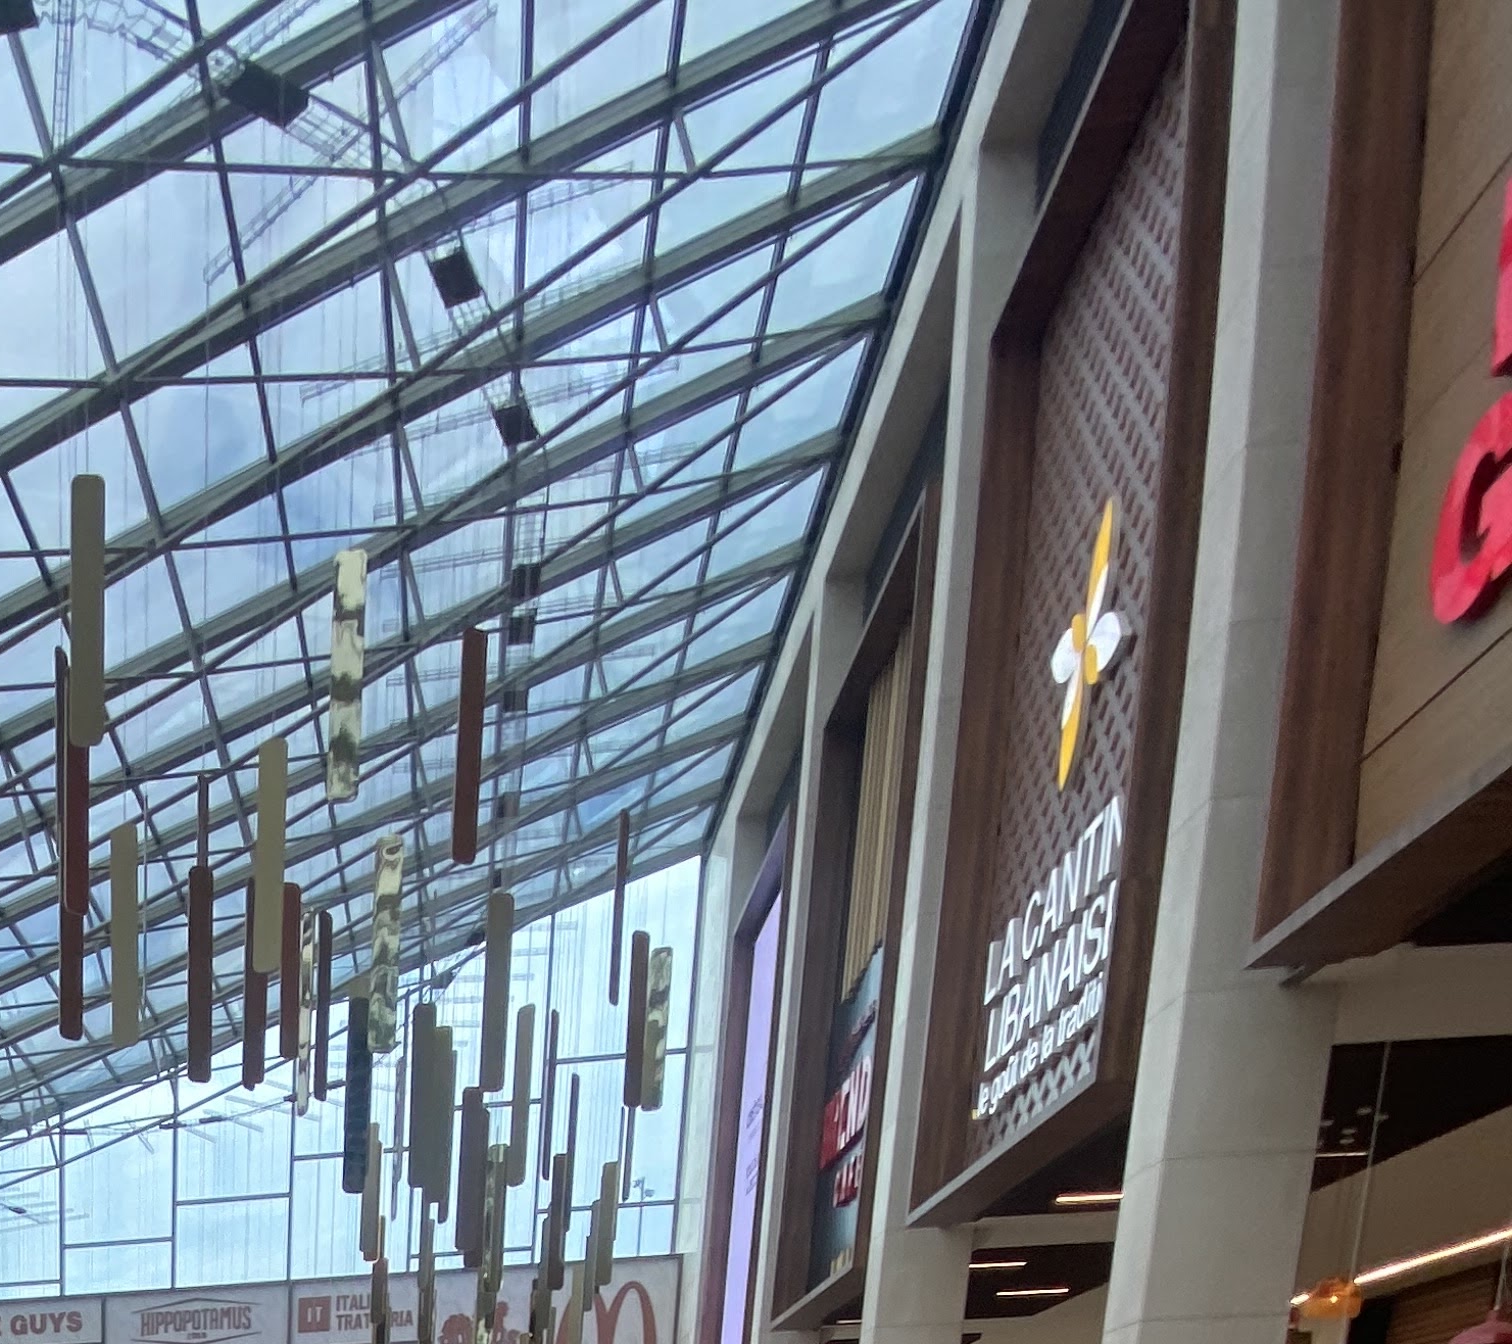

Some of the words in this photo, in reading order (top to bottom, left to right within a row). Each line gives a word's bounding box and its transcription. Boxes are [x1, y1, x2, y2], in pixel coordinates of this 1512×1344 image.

[984, 917, 1021, 1005] LA
[1020, 1038, 1039, 1080] de
[1040, 1024, 1056, 1064] la
[10, 1311, 83, 1335] GUYS
[140, 1305, 252, 1337] HIPPOPOTAMUS
[307, 1306, 324, 1324] IT
